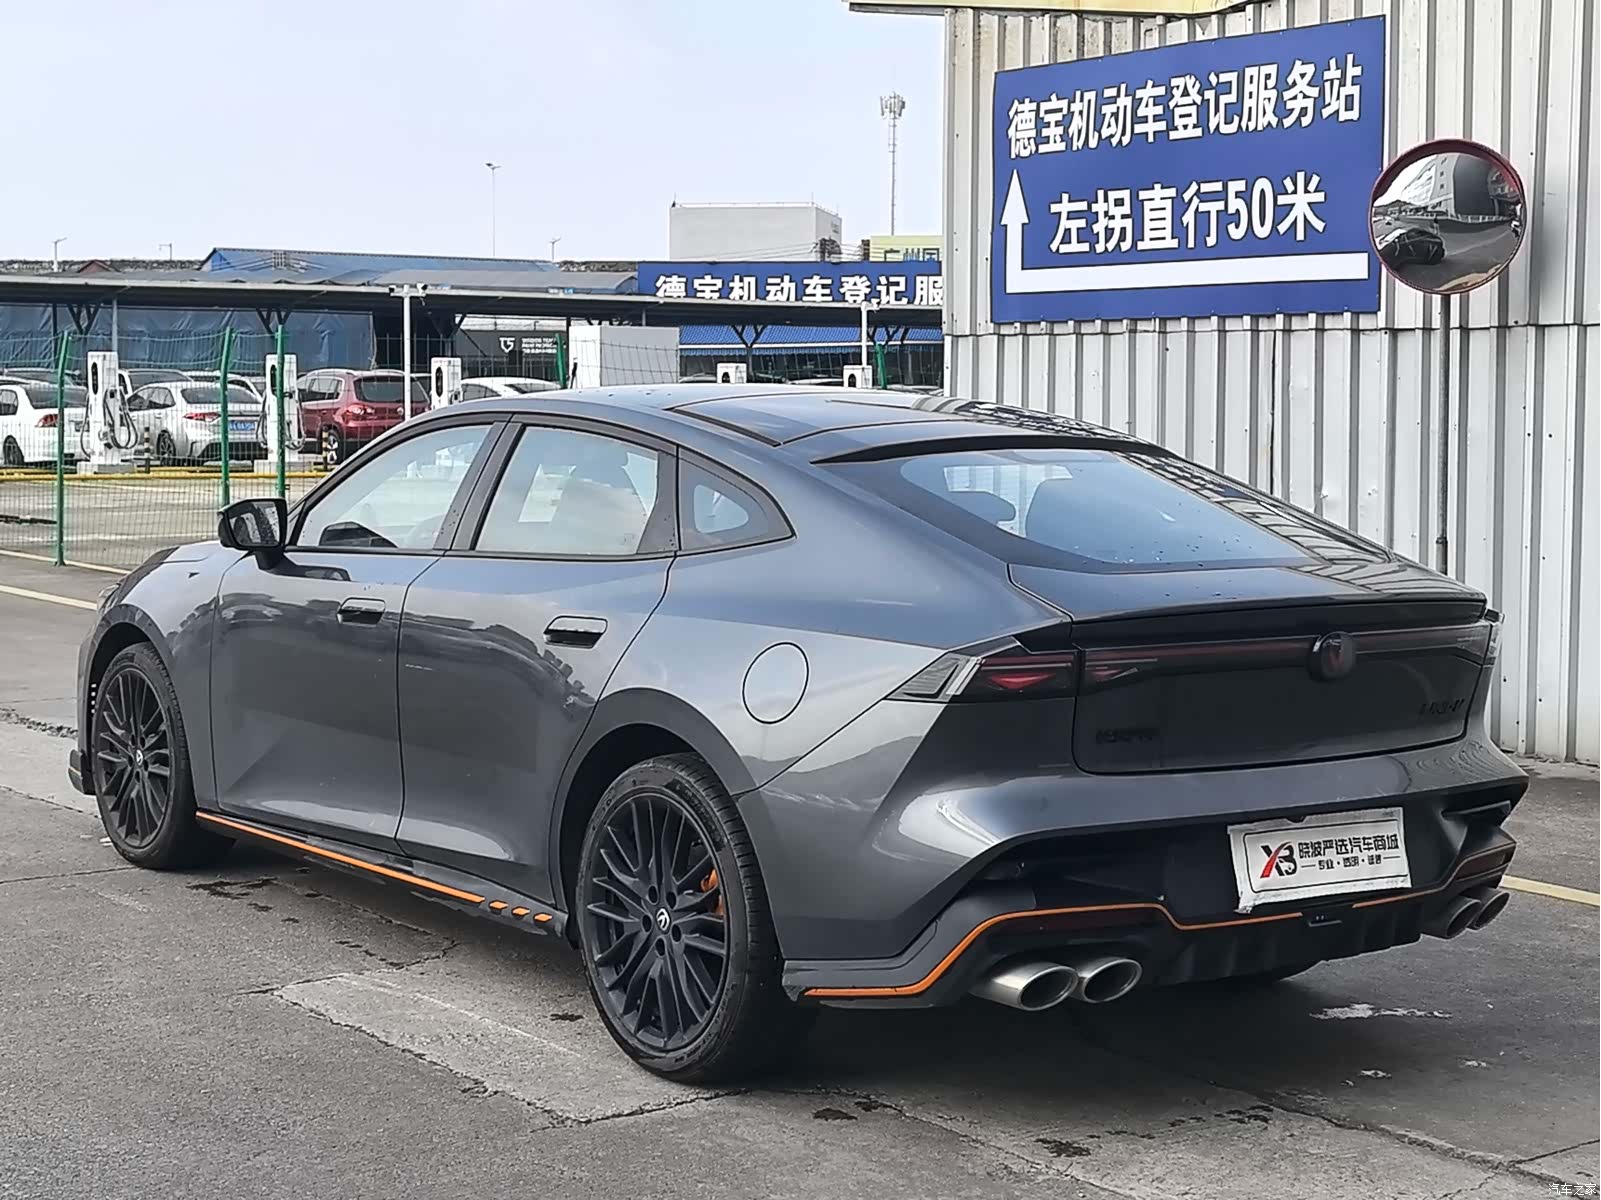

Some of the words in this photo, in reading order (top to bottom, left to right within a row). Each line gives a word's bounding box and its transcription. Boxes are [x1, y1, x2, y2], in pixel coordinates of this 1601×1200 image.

[1008, 52, 1363, 159] 德宝机动车登记服务站
[1048, 171, 1326, 255] 左拐直行50米
[655, 274, 943, 306] 德宝机动车登记服
[1298, 833, 1399, 859] 晓波严选汽车商城
